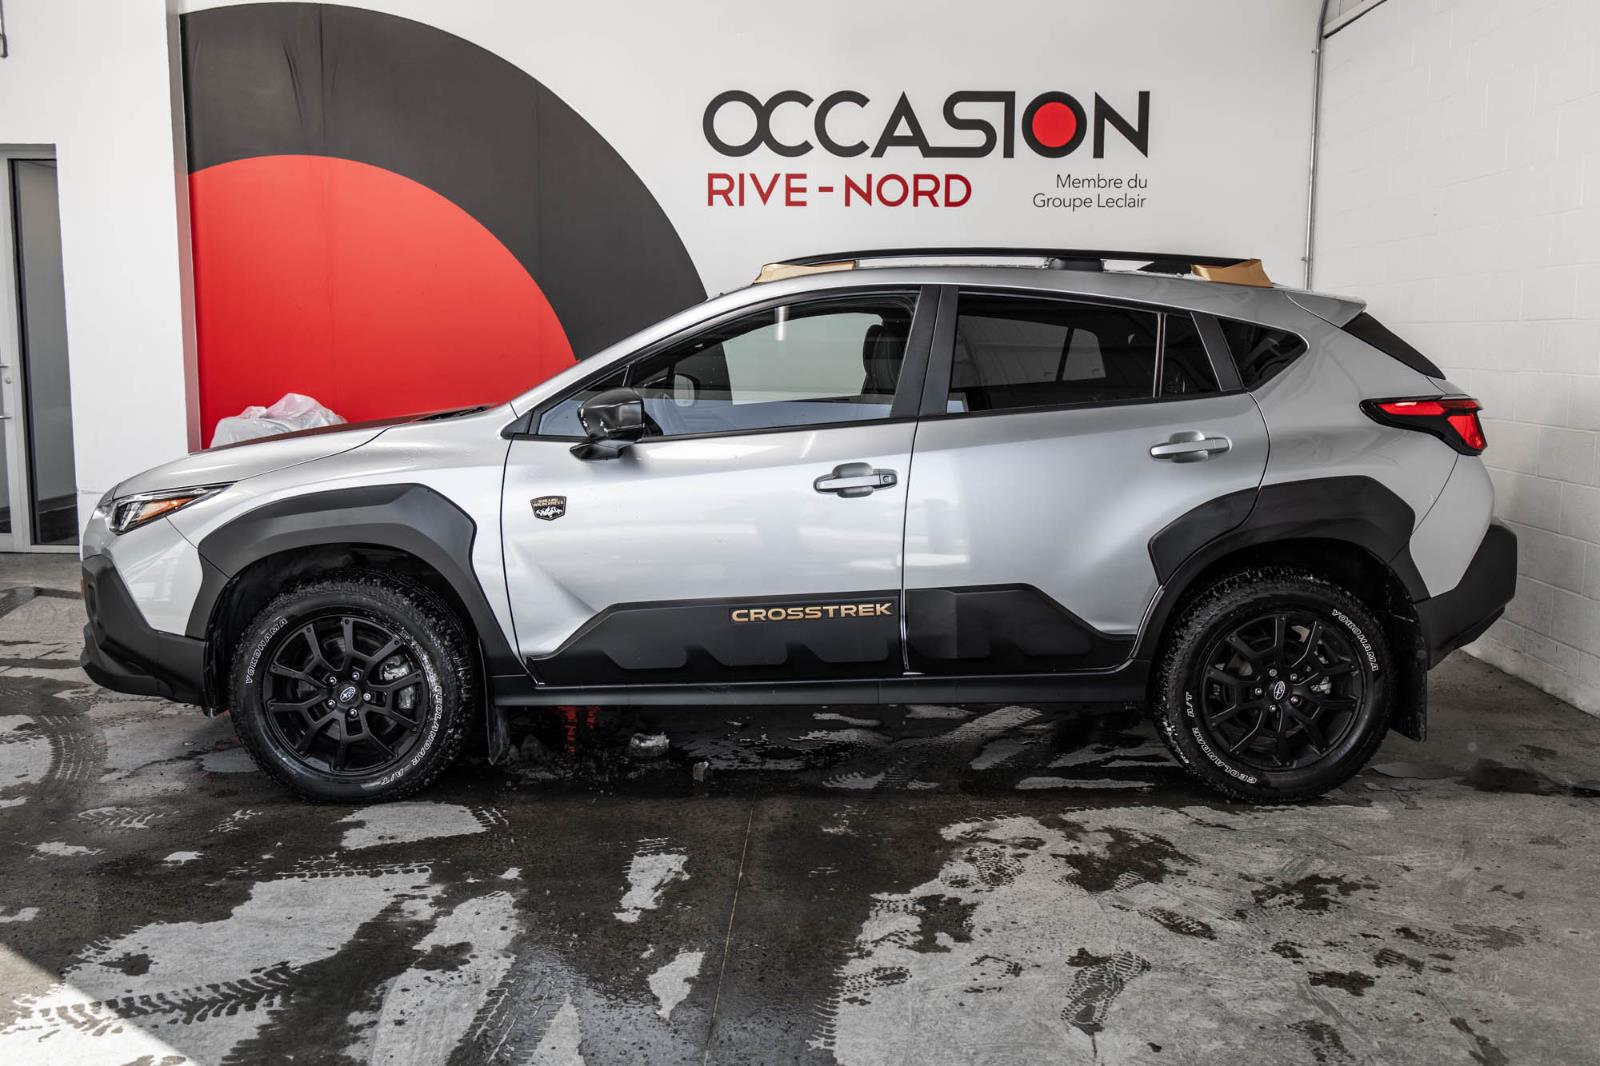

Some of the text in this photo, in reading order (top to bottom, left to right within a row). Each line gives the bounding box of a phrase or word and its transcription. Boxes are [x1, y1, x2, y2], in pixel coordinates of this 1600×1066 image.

[702, 90, 1151, 159] OCCASION
[1032, 192, 1147, 212] Groupe Leclair
[1056, 173, 1148, 189] Membre du
[731, 602, 893, 622] CROSSTREK
[1331, 608, 1379, 672] YOKOHAMA
[245, 617, 289, 684] YOKOHAMA
[410, 685, 443, 766] GEOLANDAR
[1192, 726, 1257, 784] GEOLANDAR
